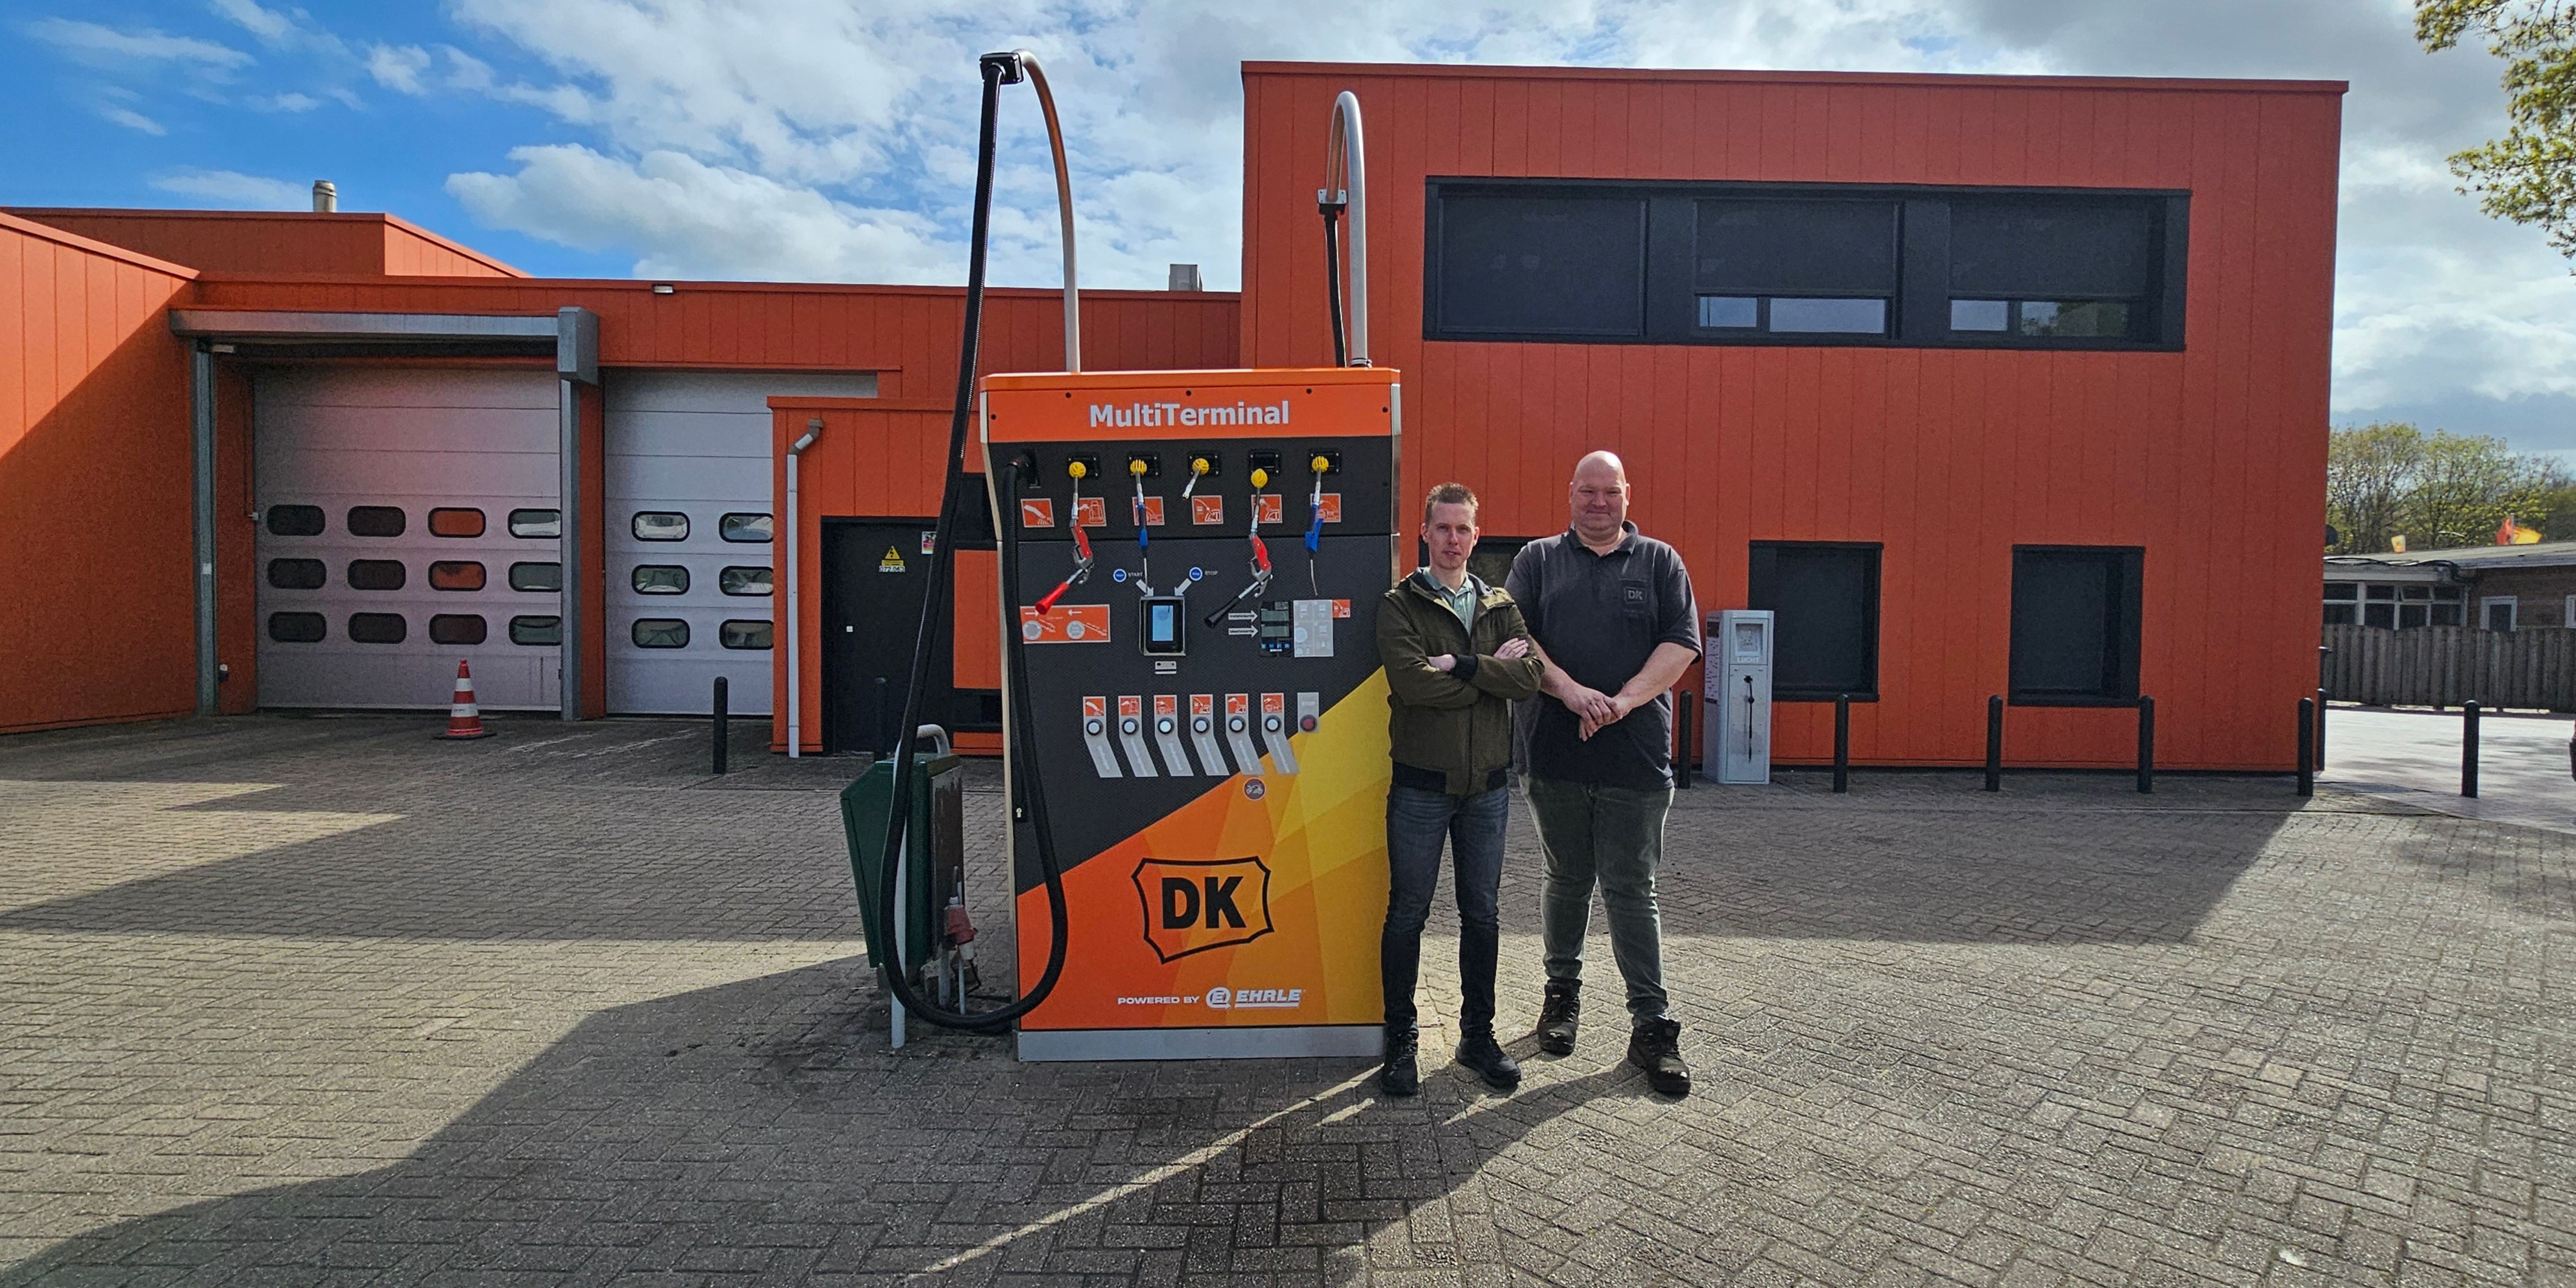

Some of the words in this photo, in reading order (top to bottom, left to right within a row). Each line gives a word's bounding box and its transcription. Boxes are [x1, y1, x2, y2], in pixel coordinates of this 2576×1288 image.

[1089, 400, 1289, 427] MultiTerminal
[1628, 590, 1643, 600] DK
[1162, 876, 1247, 929] DK
[1236, 989, 1302, 1003] EHRLE
